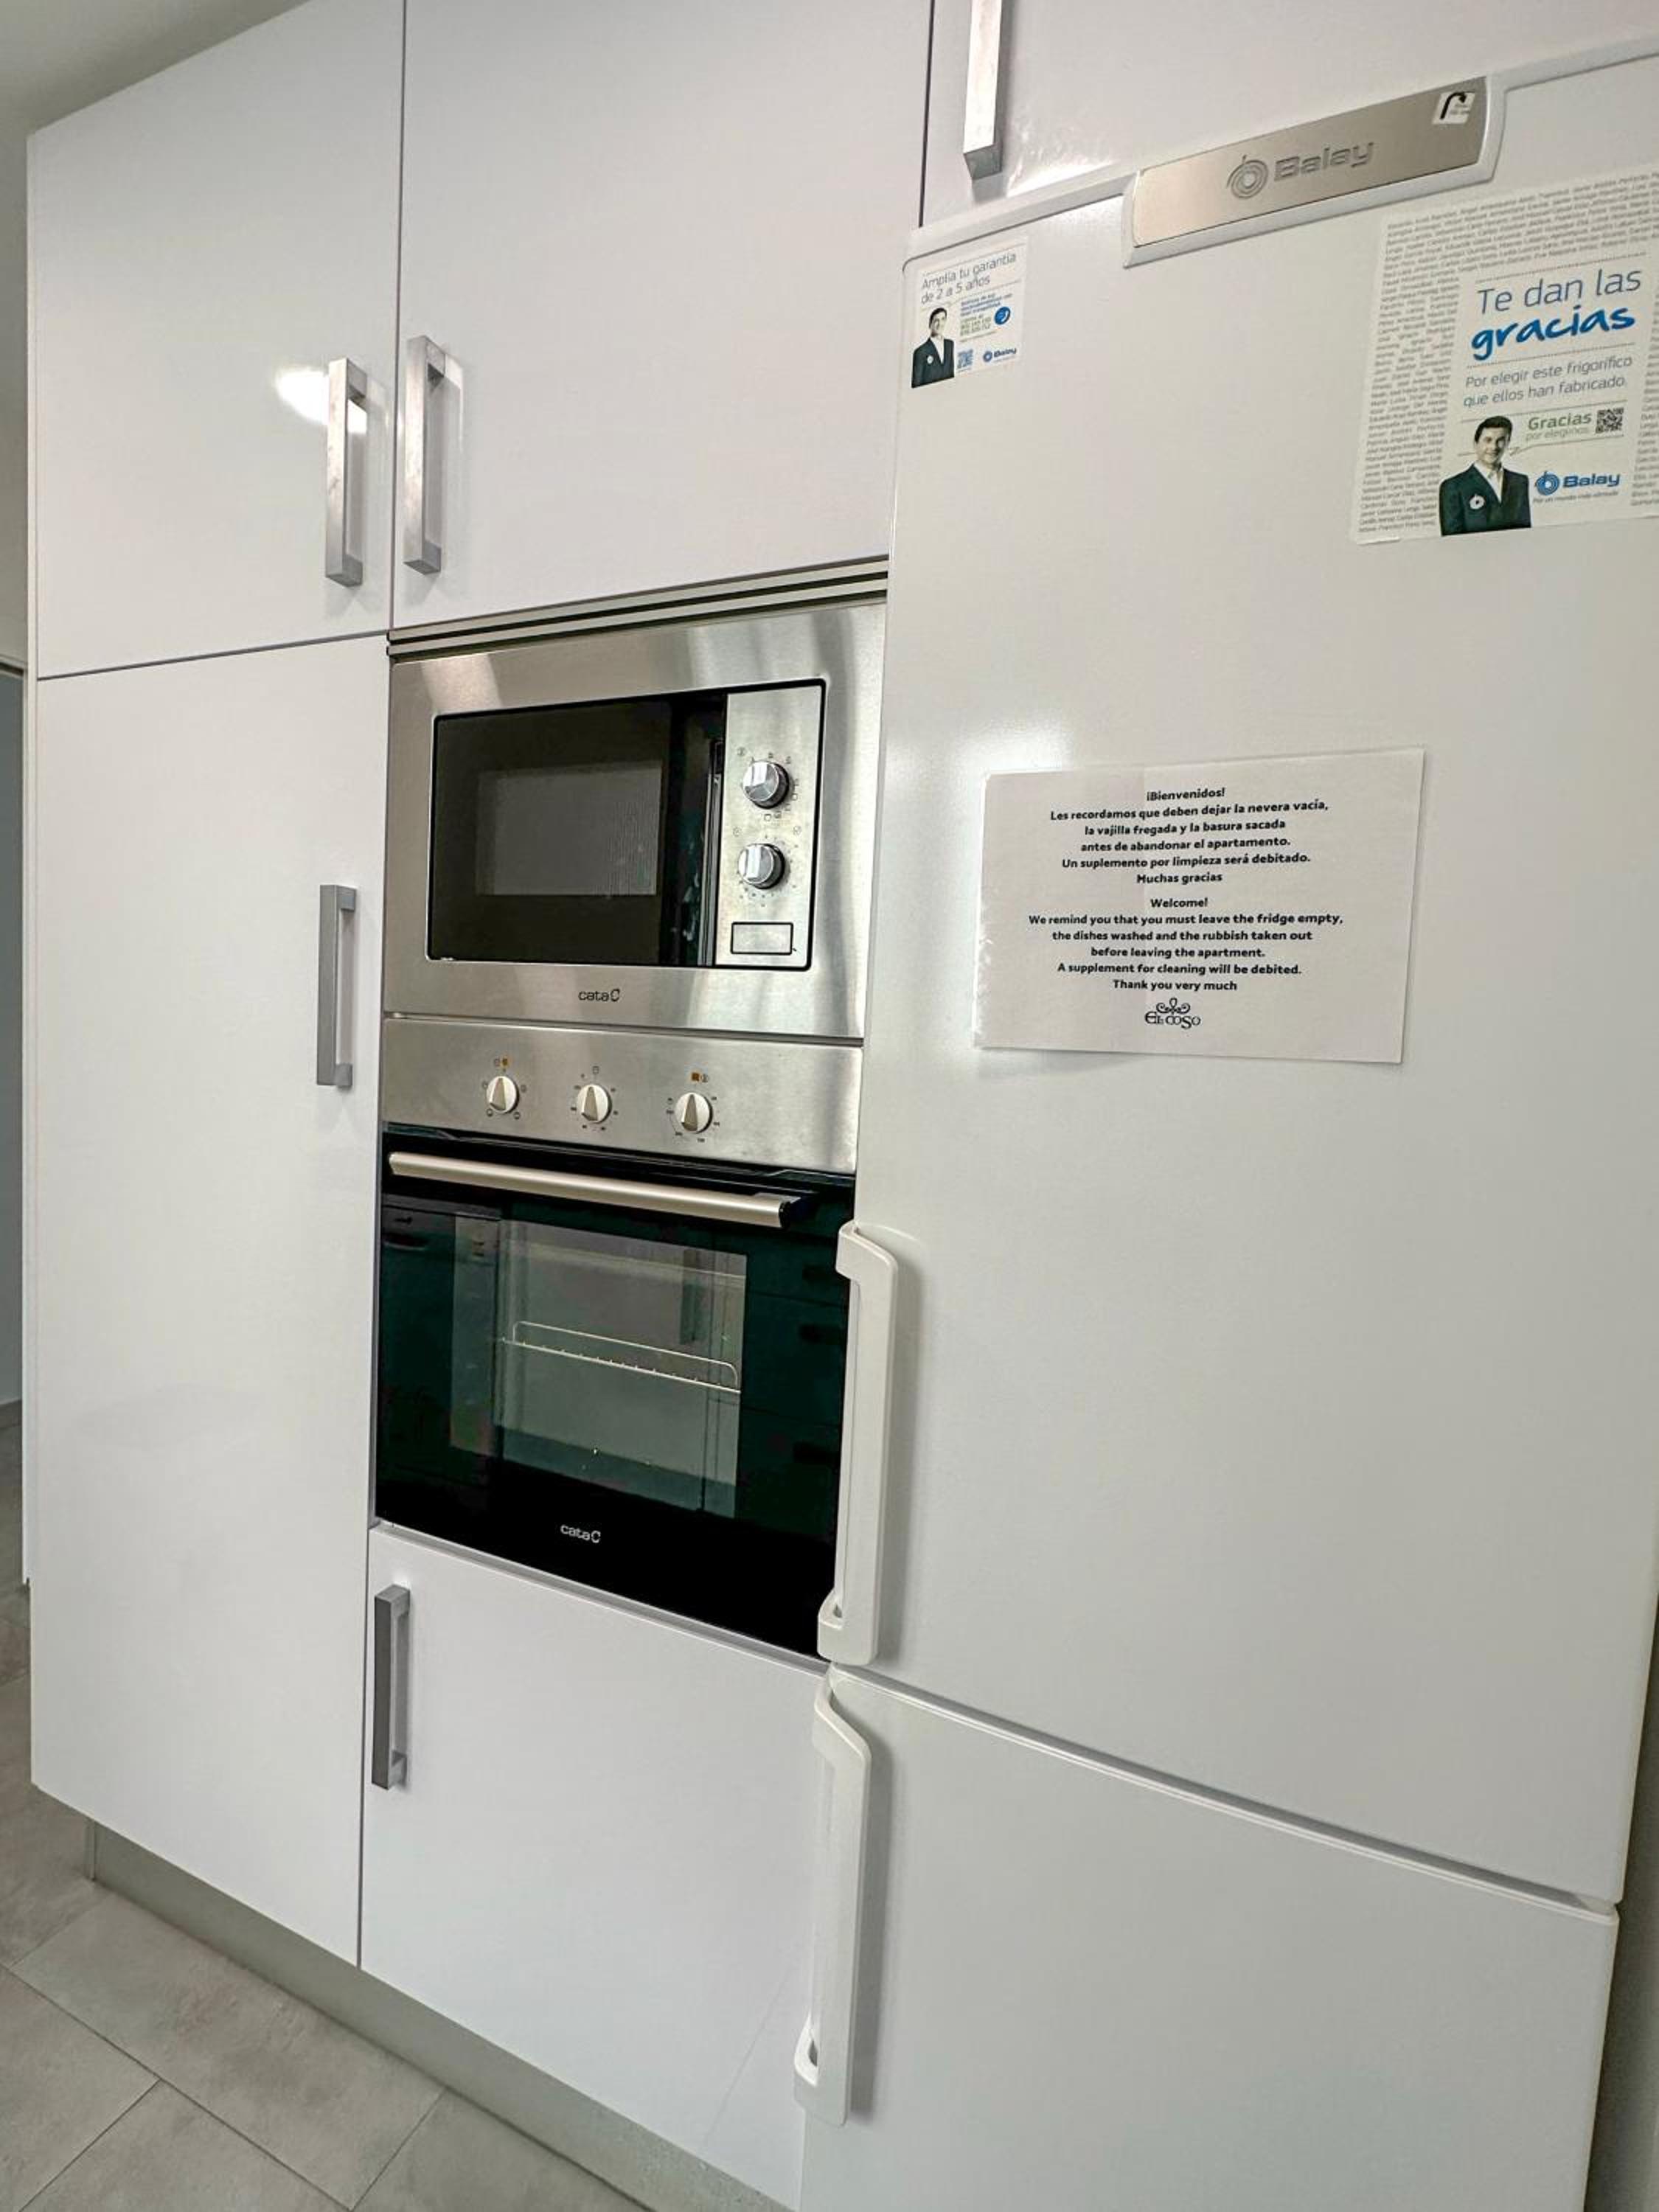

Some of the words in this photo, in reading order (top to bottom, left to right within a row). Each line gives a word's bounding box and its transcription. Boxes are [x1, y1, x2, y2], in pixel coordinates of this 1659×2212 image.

[1274, 142, 1374, 181] Balay
[959, 267, 970, 279] tu
[921, 291, 933, 304] de
[936, 288, 943, 299] 2
[946, 287, 953, 296] a
[956, 282, 962, 293] 5
[966, 275, 990, 291] años
[1476, 288, 1512, 314] Te
[1524, 278, 1583, 307] dan
[1596, 268, 1642, 296] las
[1472, 305, 1635, 361] gracias
[1465, 375, 1487, 388] Por
[1491, 369, 1530, 384] elegir
[1532, 364, 1562, 380] este
[1464, 394, 1489, 408] que
[1492, 389, 1524, 403] ellos
[1528, 384, 1554, 398] han
[1528, 413, 1591, 431] Gracias
[1564, 473, 1620, 488] Balay
[1050, 811, 1068, 821] Les
[1071, 809, 1136, 820] recordamos
[1138, 810, 1161, 820] que
[1162, 807, 1198, 817] deben
[1201, 804, 1232, 816] dejar
[1234, 803, 1245, 813] la
[1248, 804, 1290, 813] nevera
[1085, 826, 1095, 835] la
[1096, 824, 1130, 837] vajilla
[1133, 824, 1178, 837] fregada
[1180, 825, 1188, 835] y
[1189, 822, 1200, 832] la
[1203, 821, 1242, 832] basura
[1245, 818, 1286, 830] sacada
[1080, 843, 1112, 852] antes
[1114, 841, 1128, 852] de
[1130, 841, 1192, 851] abandonar
[1194, 838, 1205, 849] el
[1207, 837, 1291, 851] apartamento.
[1062, 859, 1078, 868] Un
[1080, 858, 1148, 870] suplemento
[1150, 859, 1170, 869] por
[1172, 855, 1222, 868] limpieza
[1224, 853, 1249, 865] será
[1251, 852, 1311, 863] debitado.
[1136, 873, 1179, 884] Muchas
[1181, 872, 1222, 886] gracias
[1150, 897, 1208, 908] Welcome!
[1029, 915, 1046, 925] We
[1048, 914, 1088, 924] remind
[1090, 917, 1111, 927] you
[1113, 914, 1139, 925] that
[1141, 917, 1163, 927] you
[1165, 915, 1197, 924] must
[1198, 914, 1231, 924] leave
[1232, 914, 1254, 924] the
[1256, 912, 1295, 926] fridge
[1297, 914, 1343, 925] empty,
[1052, 931, 1071, 940] the
[1073, 931, 1108, 940] dishes
[1110, 931, 1153, 941] washed
[1155, 931, 1178, 941] and
[1179, 931, 1200, 941] the
[1203, 930, 1248, 941] rubbish
[1251, 930, 1287, 940] taken
[1290, 931, 1313, 940] out
[1091, 947, 1128, 956] before
[1130, 947, 1172, 959] leaving
[1174, 947, 1195, 957] the
[1197, 948, 1265, 959] apartment.
[1057, 962, 1066, 972] A
[1068, 962, 1135, 975] supplement
[1137, 964, 1155, 973] for
[1157, 963, 1206, 976] cleaning
[1208, 964, 1231, 974] will
[1234, 964, 1248, 974] be
[1250, 964, 1302, 975] debited.
[1113, 979, 1148, 990] Thank
[1150, 982, 1173, 992] you
[1175, 982, 1201, 992] very
[1203, 981, 1237, 991] much
